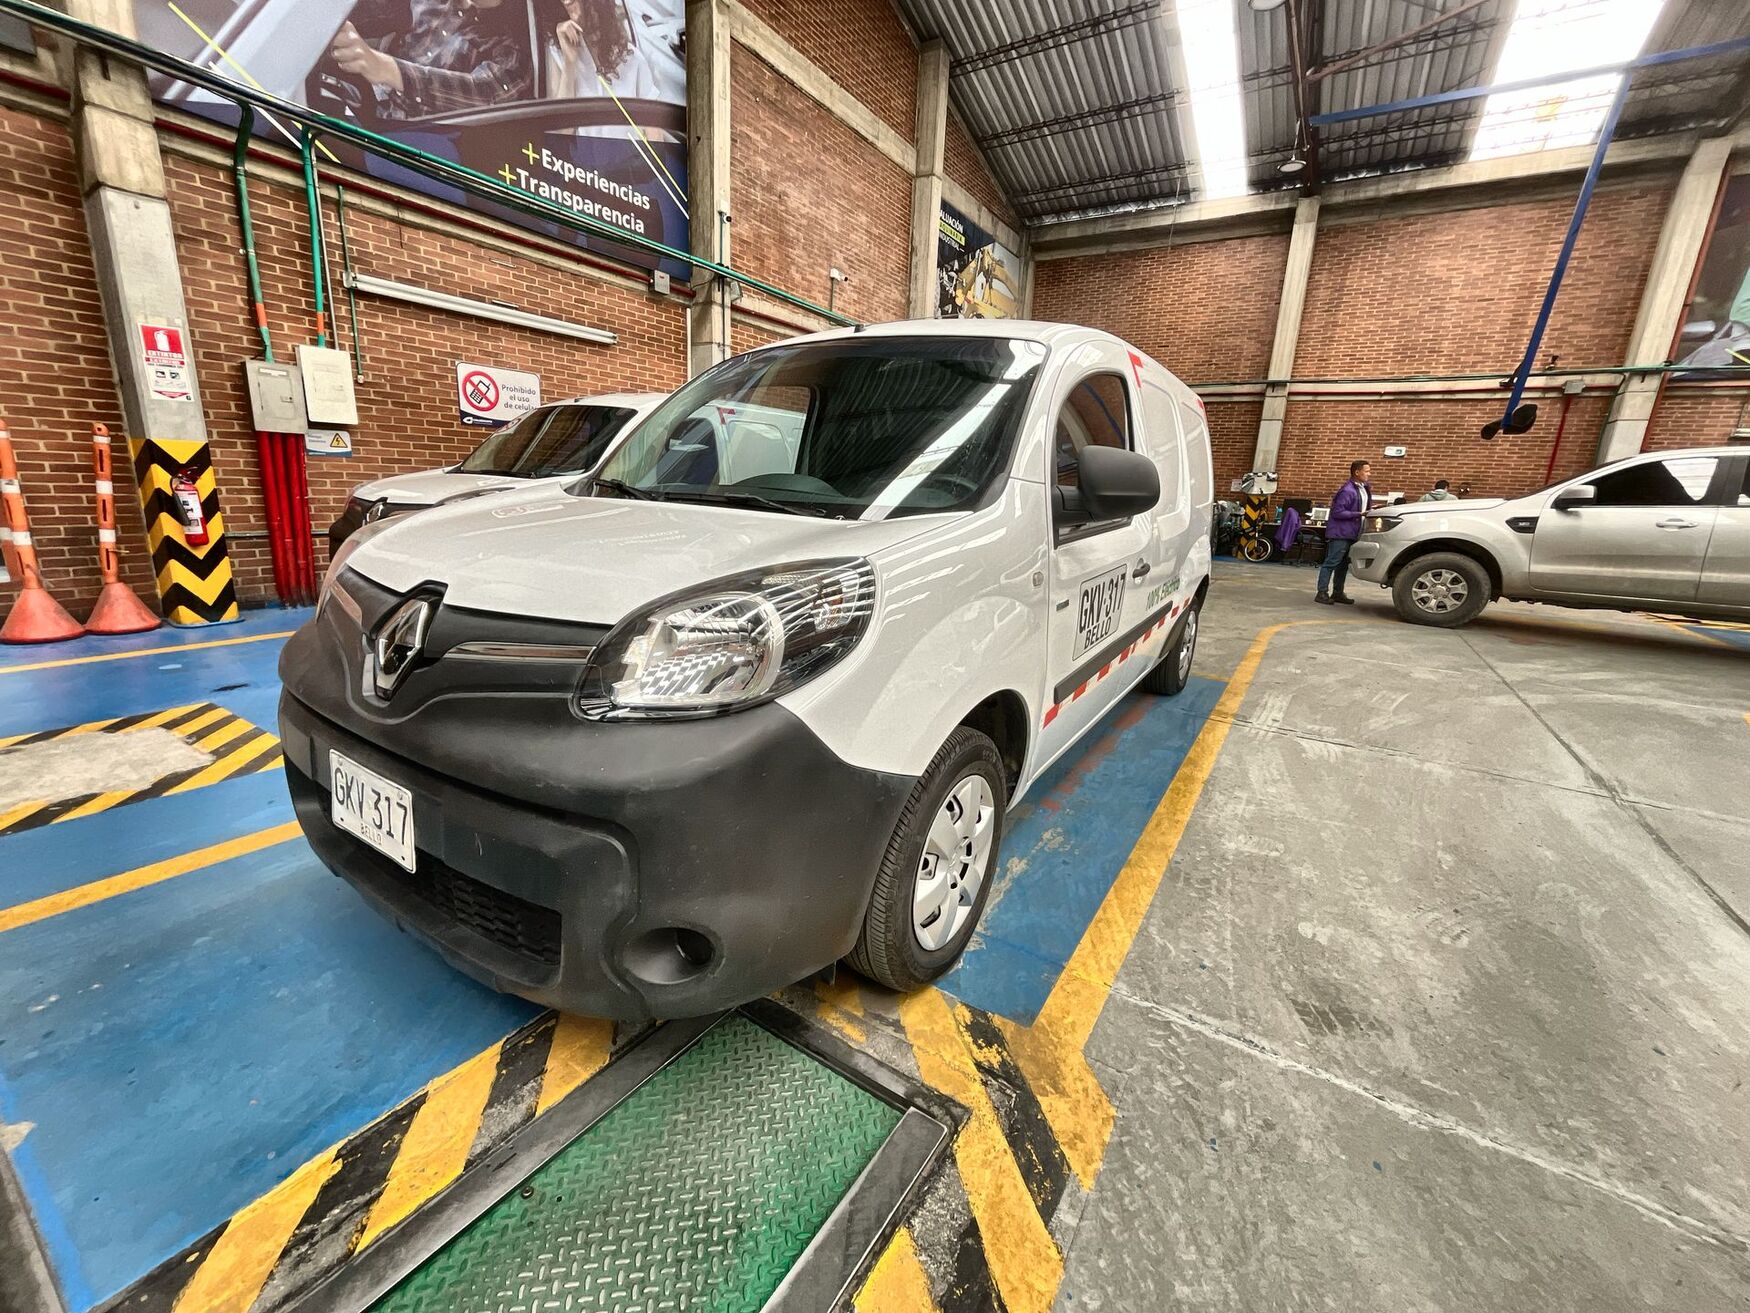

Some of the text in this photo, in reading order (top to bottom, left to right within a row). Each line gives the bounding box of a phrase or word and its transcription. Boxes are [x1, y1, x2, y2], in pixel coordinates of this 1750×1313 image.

[501, 384, 536, 396] Prohibido
[509, 394, 516, 402] el
[504, 402, 513, 410] de
[1084, 616, 1111, 650] BELLO
[335, 767, 408, 846] GKV 317
